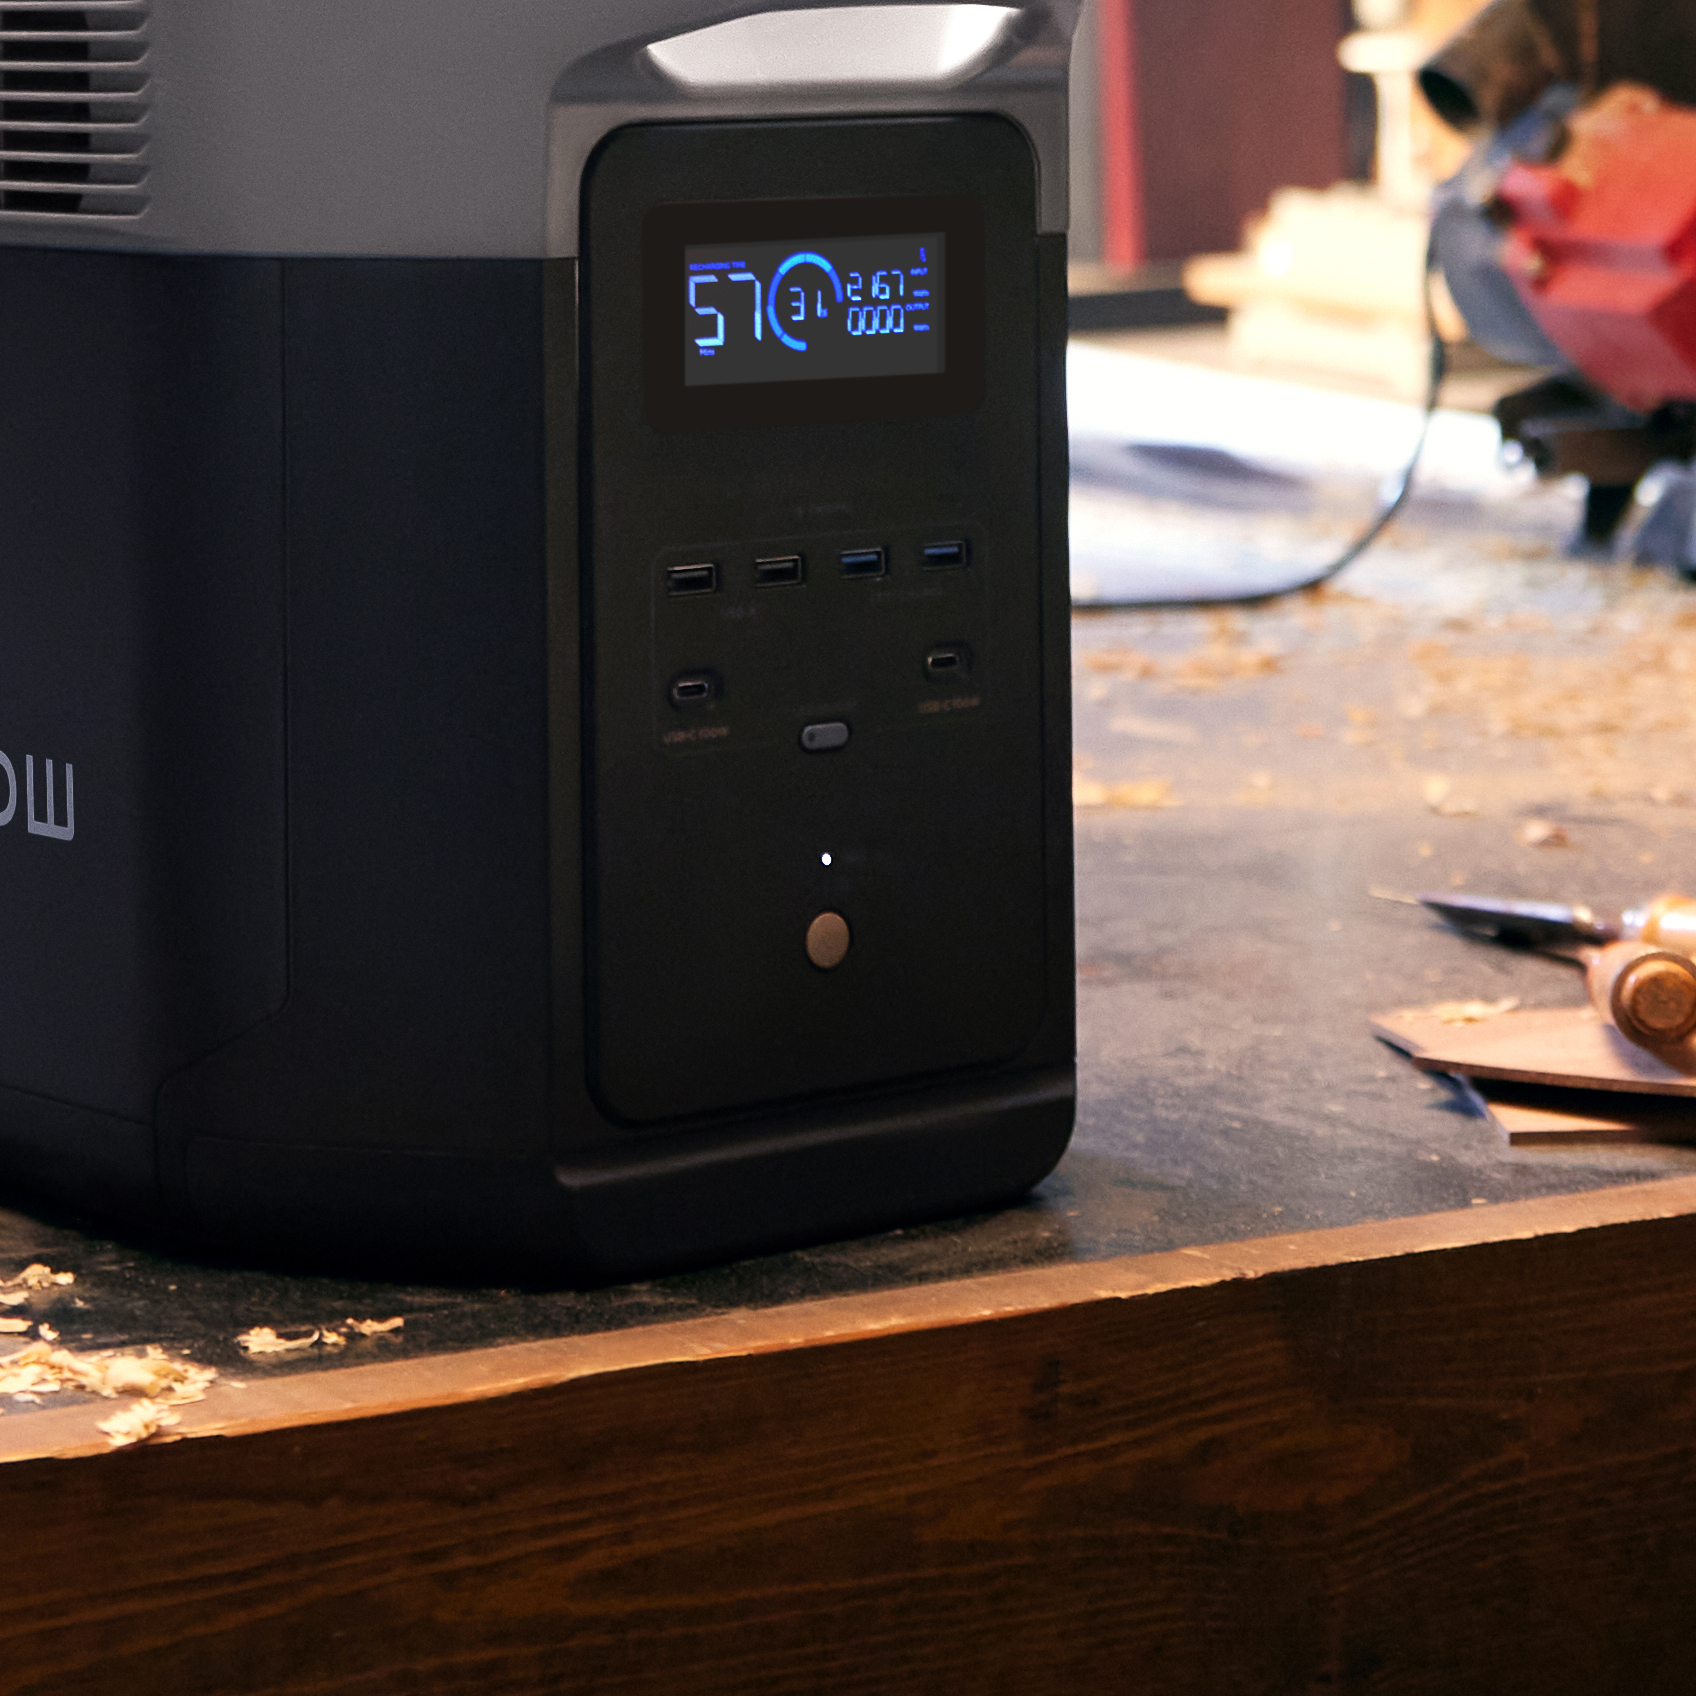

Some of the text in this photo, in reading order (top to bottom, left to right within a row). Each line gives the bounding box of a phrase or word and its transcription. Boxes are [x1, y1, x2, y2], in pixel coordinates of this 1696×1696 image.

[845, 269, 905, 302] 2167
[688, 271, 763, 348] 57
[846, 304, 905, 336] 0000
